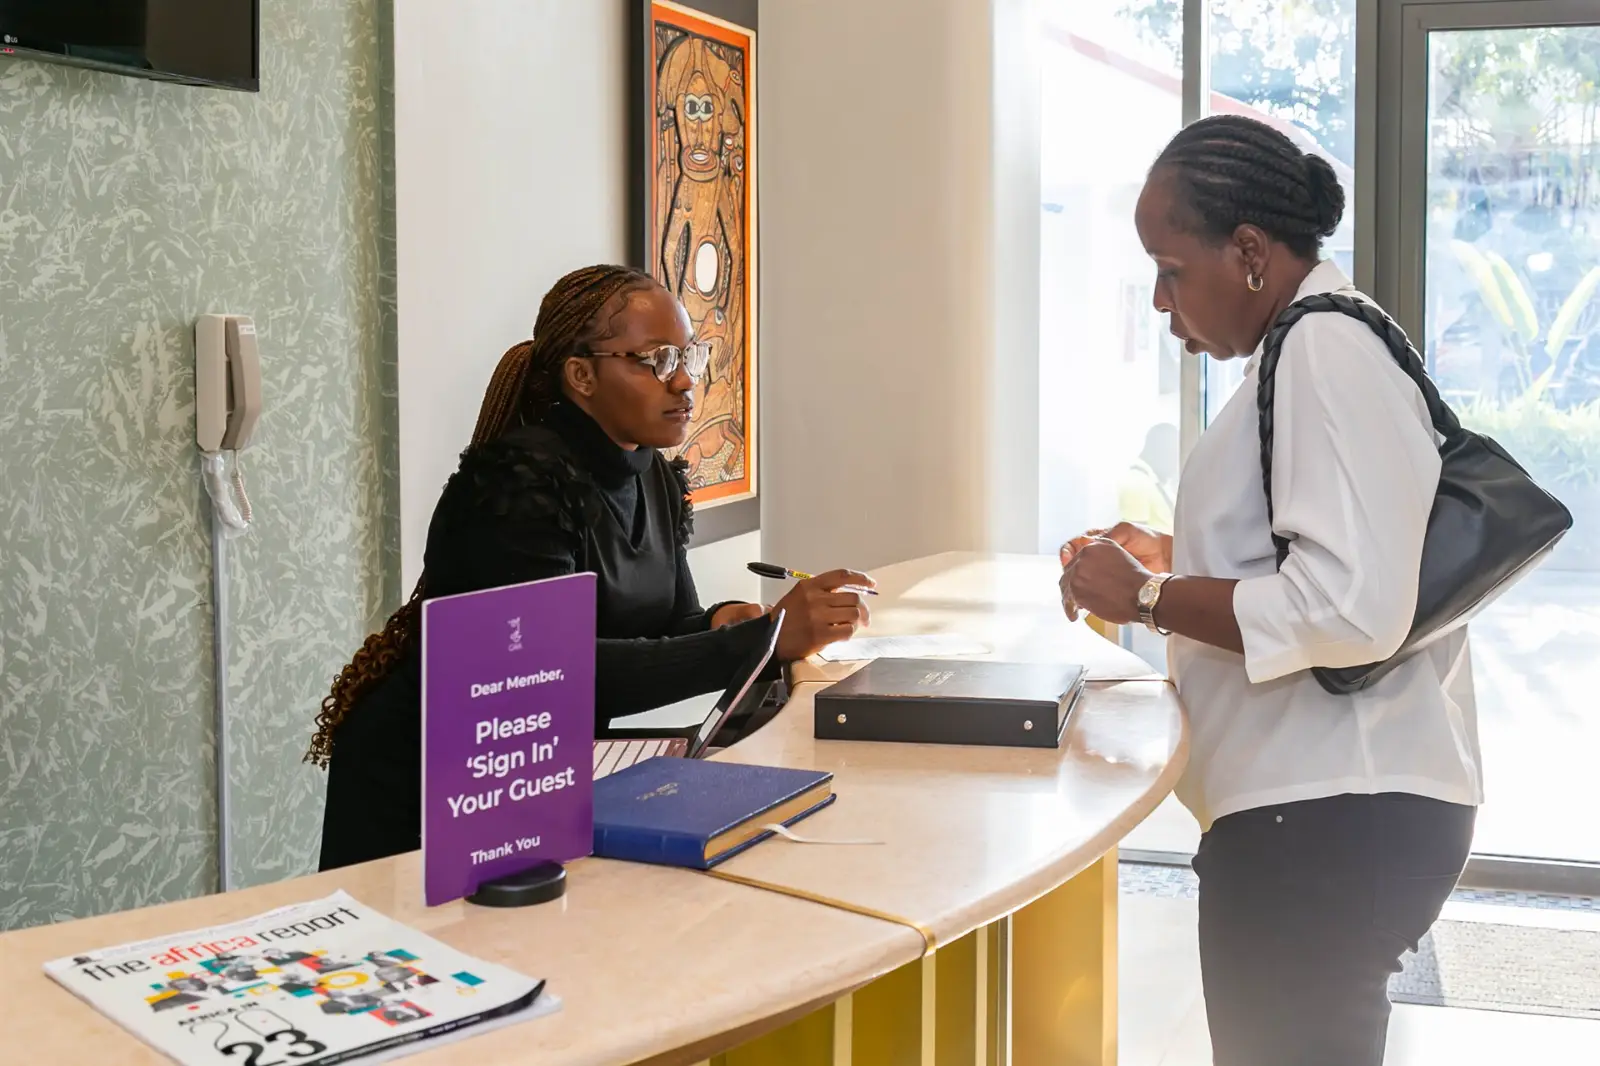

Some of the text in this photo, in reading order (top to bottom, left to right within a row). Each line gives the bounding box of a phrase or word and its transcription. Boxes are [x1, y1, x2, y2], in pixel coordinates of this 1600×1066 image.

[470, 668, 565, 698] Dear Member,
[475, 711, 552, 745] Please
[447, 766, 576, 819] Your Guest
[470, 835, 541, 865] Thank You
[82, 906, 361, 982] the africa report
[220, 1029, 328, 1066] 23
